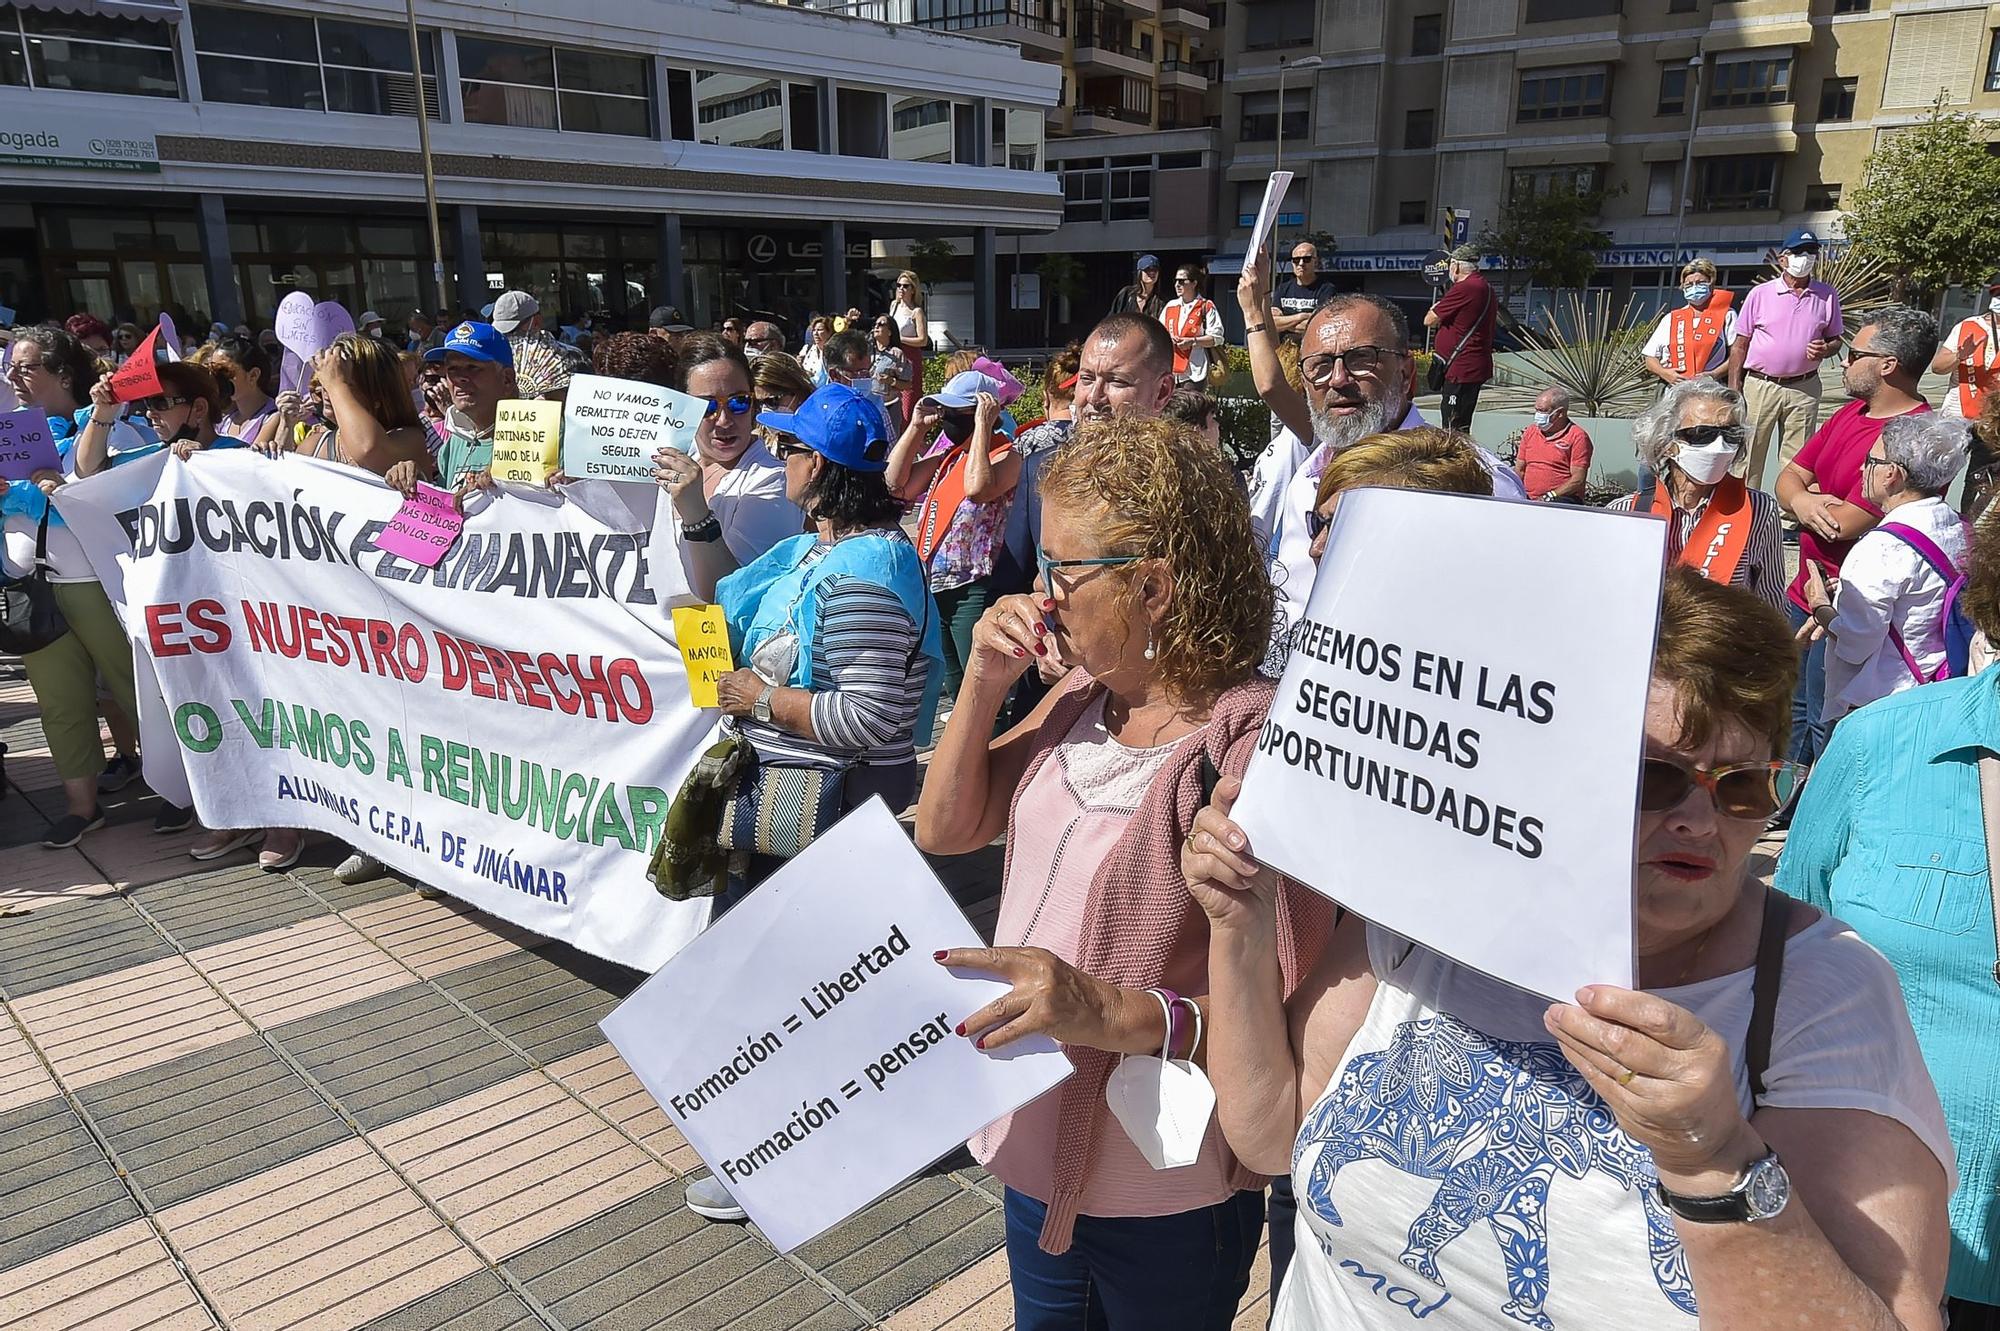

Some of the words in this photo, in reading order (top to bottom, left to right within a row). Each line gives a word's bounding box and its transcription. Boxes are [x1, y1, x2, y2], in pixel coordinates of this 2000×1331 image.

[1457, 221, 1465, 239] P
[787, 241, 869, 258] LES
[593, 390, 612, 400] NO
[616, 392, 660, 407] VAMOS
[663, 402, 673, 411] A
[499, 411, 509, 421] NO
[512, 411, 517, 421] A
[518, 411, 537, 422] LAS
[575, 406, 630, 420] PERMITIR
[634, 412, 661, 424] QUE
[663, 417, 685, 429] NO
[20, 432, 41, 443] NO
[533, 431, 546, 443] DE
[591, 426, 615, 437] NOS
[619, 428, 658, 441] DEJEN
[494, 450, 518, 461] HUMO
[520, 450, 531, 462] DE
[532, 451, 540, 462] LA
[601, 445, 641, 458] SEGUIR
[114, 488, 350, 566] EDUCACIÓN
[398, 504, 420, 519] MÁS
[421, 511, 461, 533] DIÁLOGO
[387, 520, 411, 534] CON
[409, 527, 430, 541] LOS
[144, 598, 233, 658] ES
[240, 599, 428, 684] NUESTRO
[433, 630, 654, 725] DERECHO
[1412, 650, 1464, 700] EN
[1476, 666, 1556, 724] LAS
[1296, 678, 1481, 769] SEGUNDAS
[173, 701, 224, 753] O
[230, 698, 376, 776] VAMOS
[386, 727, 413, 788] A
[420, 734, 669, 855] RENUNCIAR
[1258, 718, 1544, 859] OPORTUNIDADES
[368, 805, 430, 854] C.E.P.A.
[441, 831, 467, 868] DE
[473, 844, 568, 905] JINÁMAR
[669, 1036, 784, 1120] Formación
[800, 924, 911, 1020] Libertad
[720, 1101, 841, 1185] Formación
[864, 1011, 954, 1091] pensar
